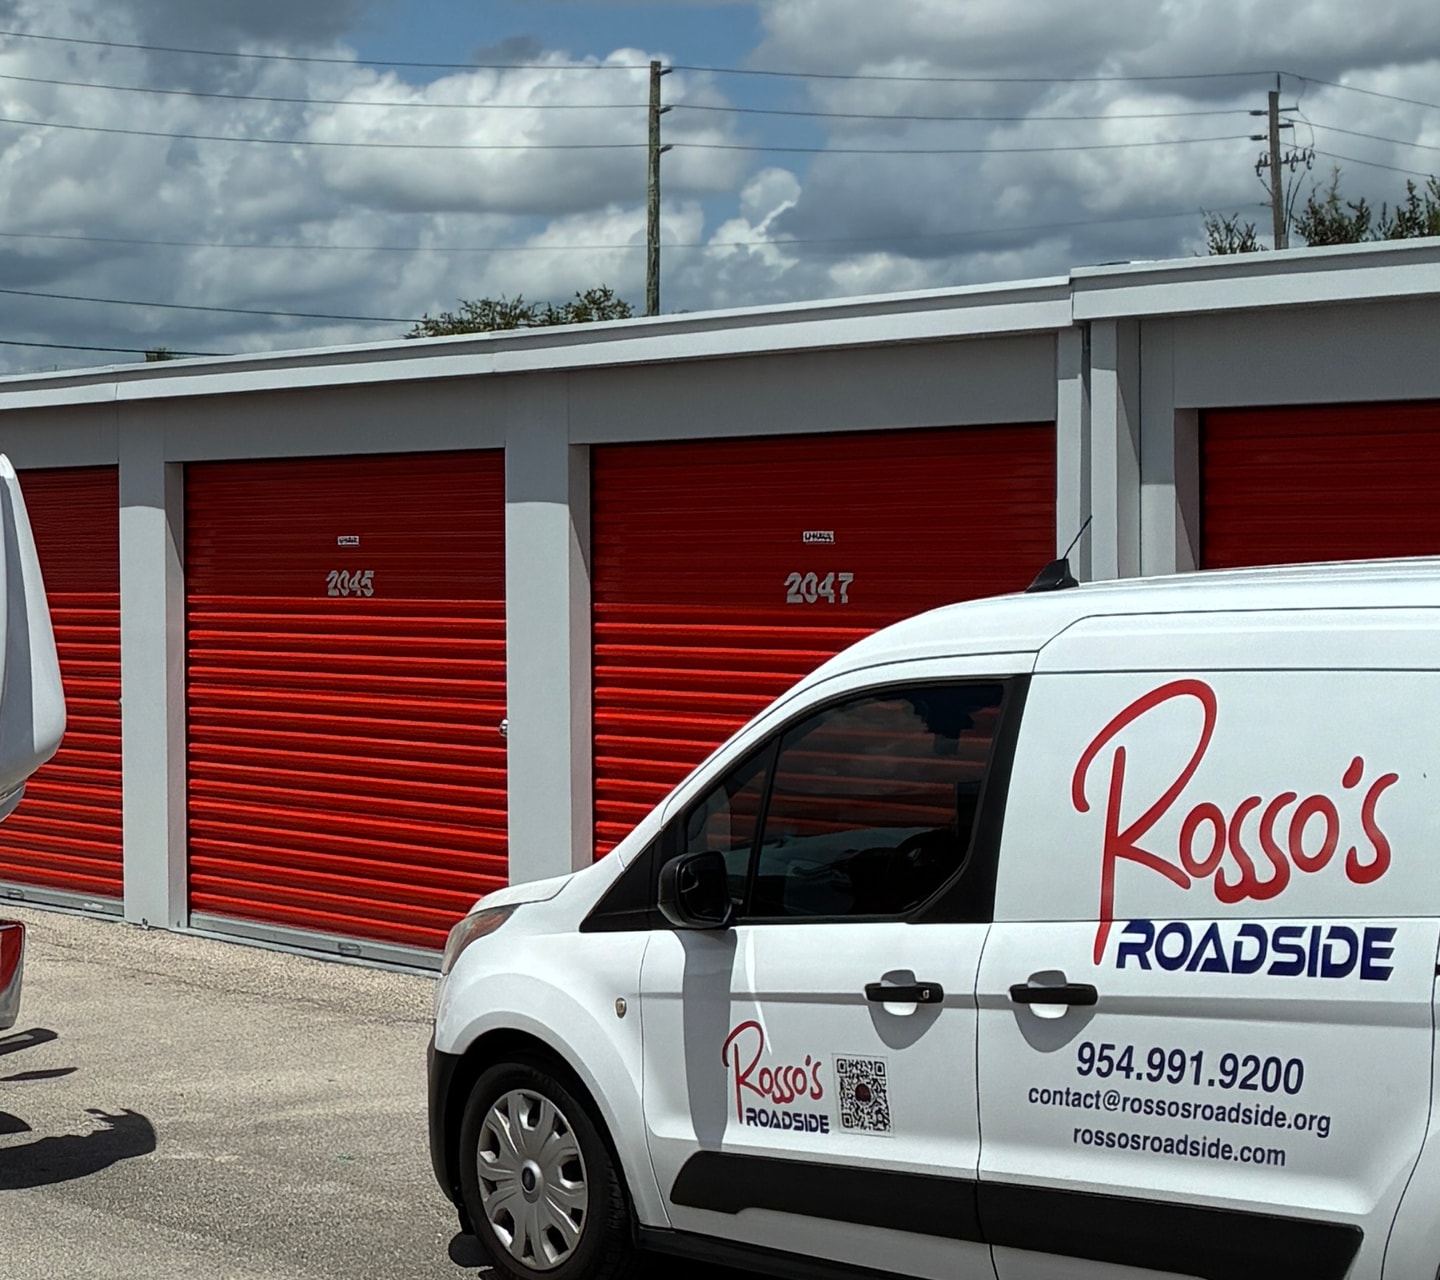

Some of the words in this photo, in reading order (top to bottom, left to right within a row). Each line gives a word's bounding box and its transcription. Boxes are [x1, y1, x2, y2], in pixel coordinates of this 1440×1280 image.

[325, 569, 375, 597] 2045
[783, 571, 854, 604] 2047
[1071, 678, 1400, 966] Rosso's
[1116, 919, 1399, 982] ROADSIDE
[722, 1020, 824, 1125] Rosso's
[1076, 1040, 1305, 1096] 954.991.9200
[745, 1107, 830, 1135] ROADSIDE
[1027, 1083, 1332, 1139] contact@rossosroadside.org
[1073, 1127, 1287, 1167] rossosroadside.com
